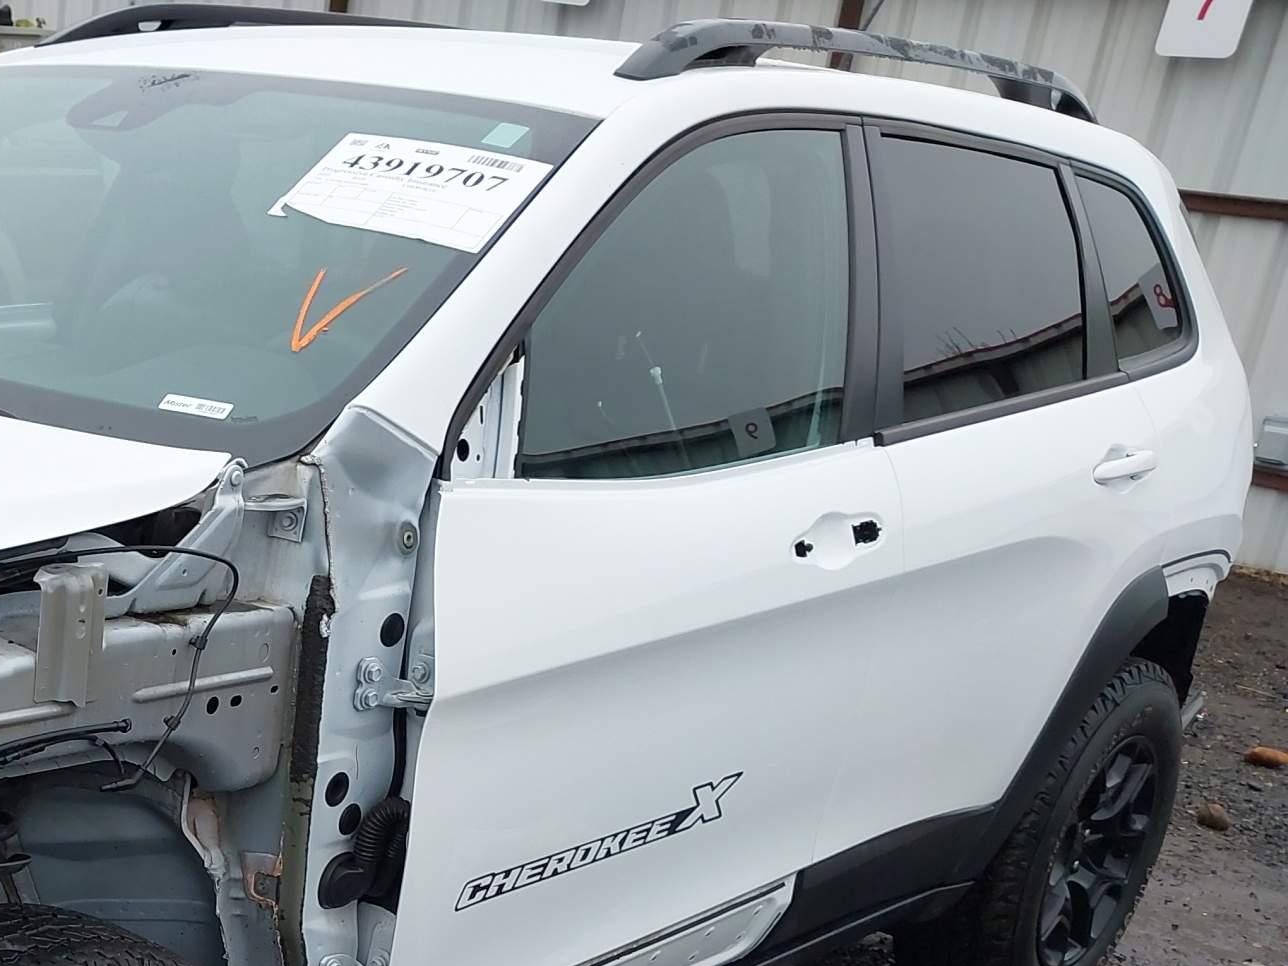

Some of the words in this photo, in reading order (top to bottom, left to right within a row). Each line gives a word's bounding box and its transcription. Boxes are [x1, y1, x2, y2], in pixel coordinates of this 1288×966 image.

[341, 153, 509, 192] 43919707
[455, 813, 679, 912] CHEROKEE
[675, 771, 744, 832] X
